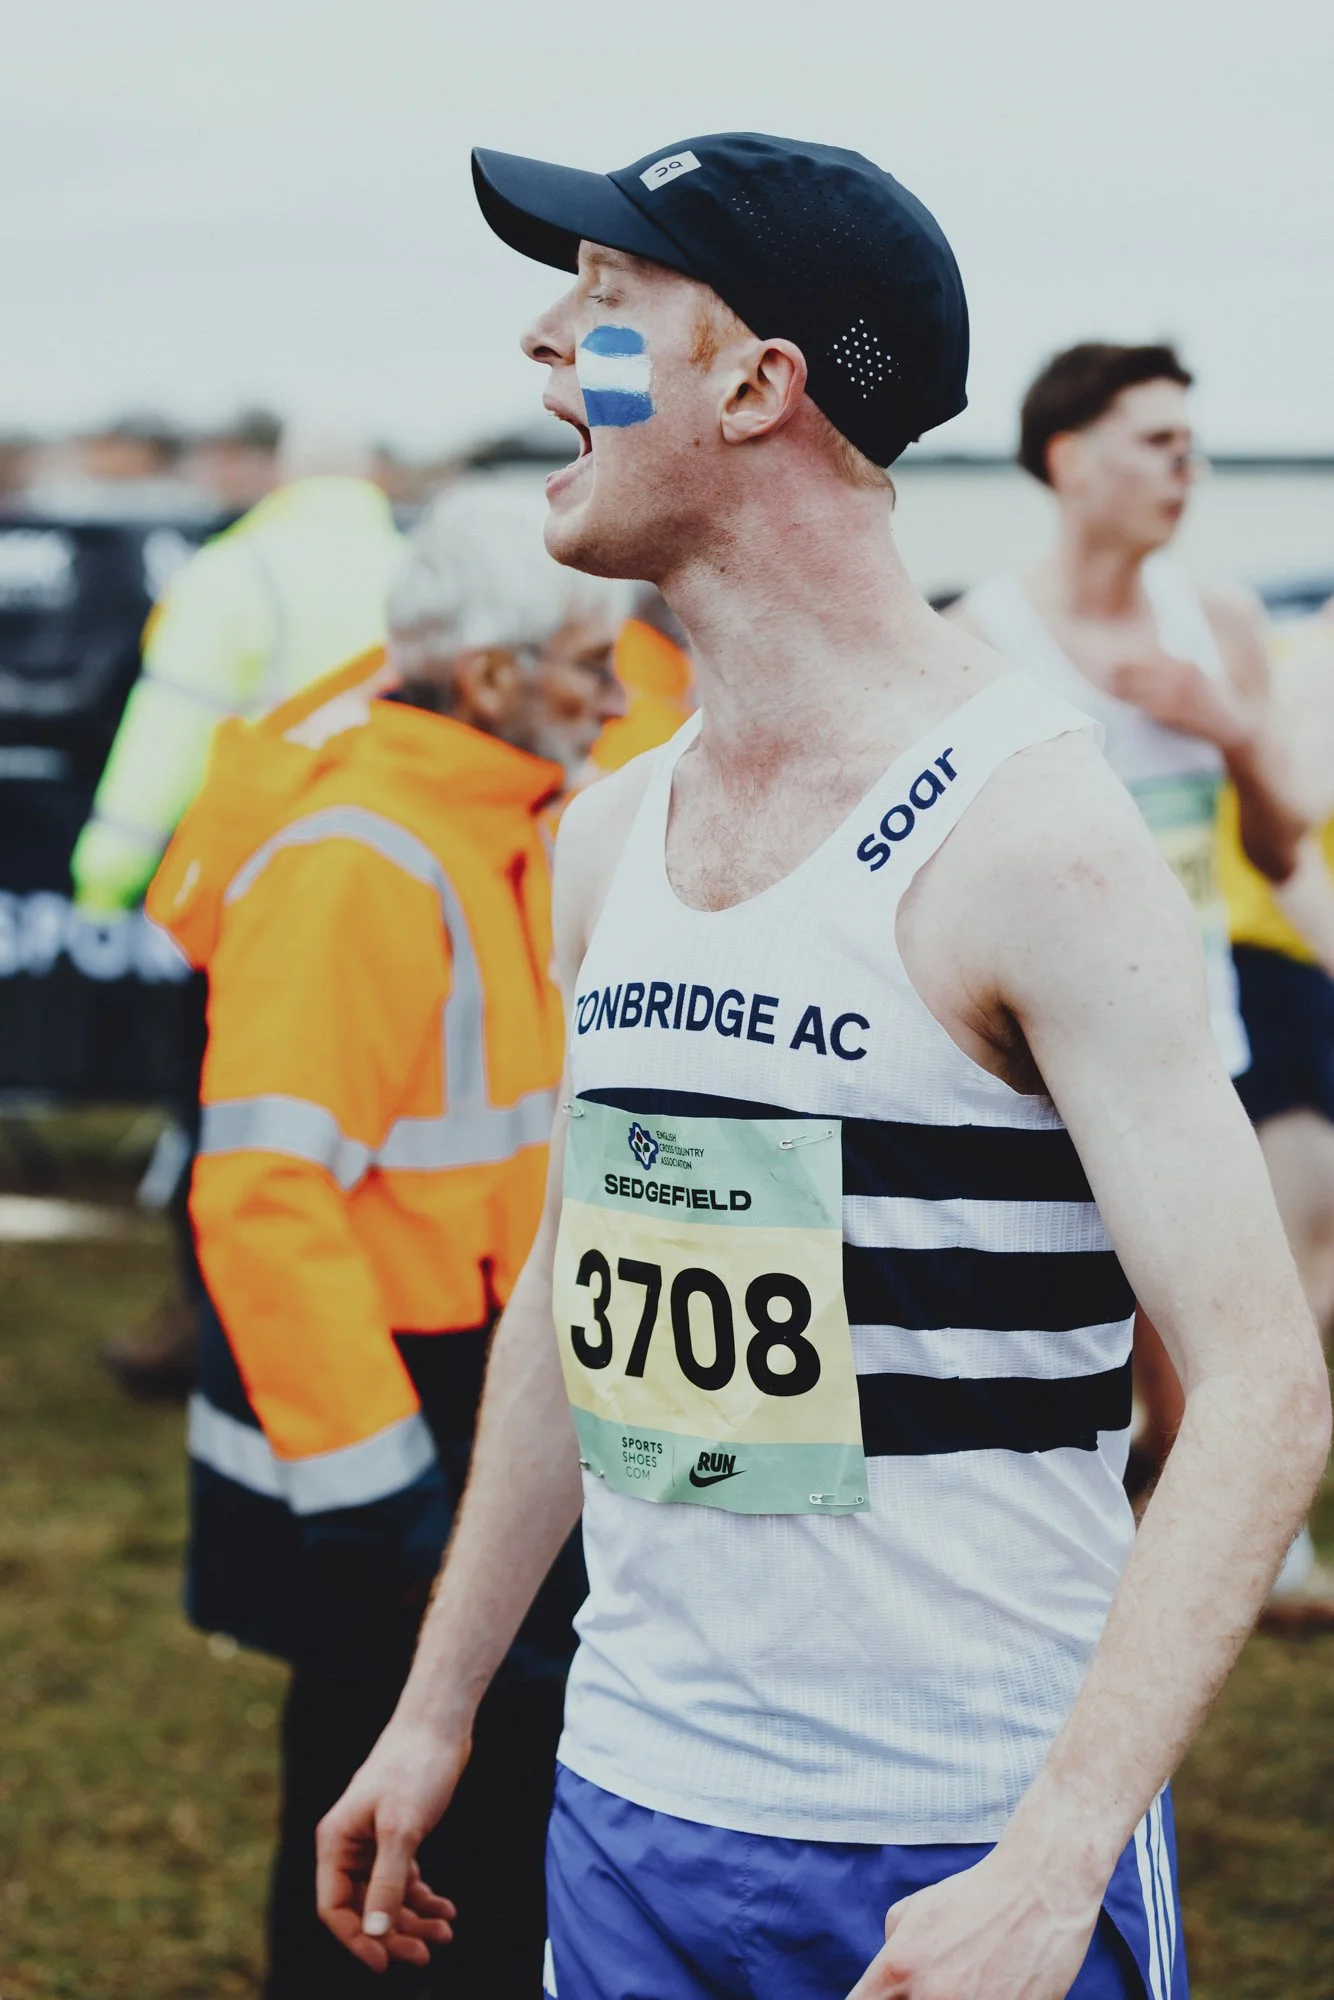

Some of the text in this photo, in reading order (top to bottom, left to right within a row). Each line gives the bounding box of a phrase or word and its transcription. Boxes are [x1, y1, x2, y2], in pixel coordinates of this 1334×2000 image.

[856, 747, 958, 872] soar
[573, 981, 871, 1061] TONBRIDGE AC
[656, 1130, 677, 1142] ENGLISH
[659, 1143, 705, 1158] CROSS COUNTRY
[660, 1156, 692, 1170] ASSOCIATION
[604, 1173, 752, 1211] SEDGEFIELD
[571, 1248, 821, 1397] 3708
[621, 1436, 663, 1455] SPORTS
[622, 1451, 657, 1468] SHOES
[697, 1451, 737, 1474] RUN
